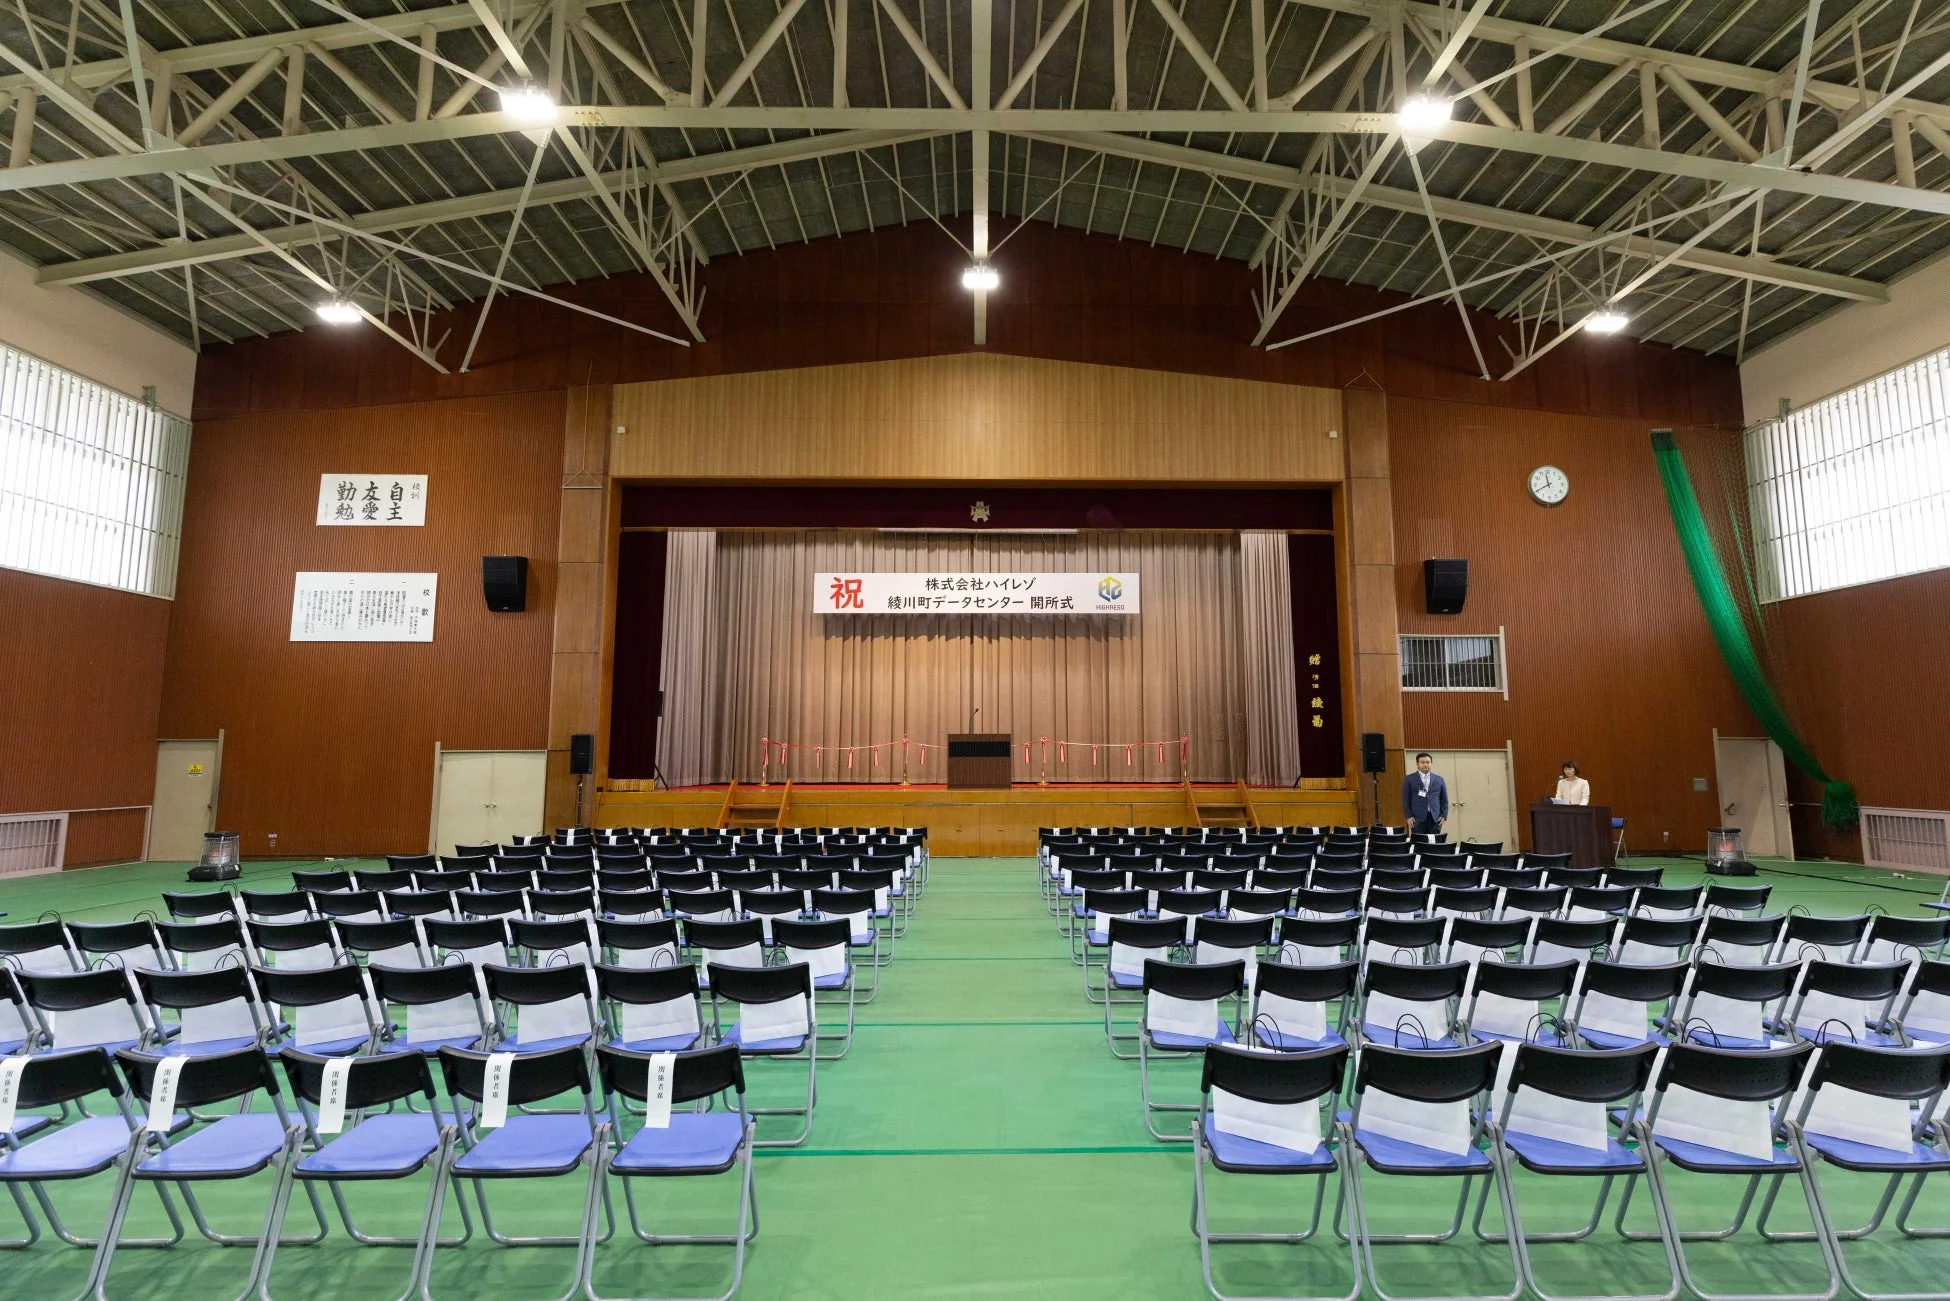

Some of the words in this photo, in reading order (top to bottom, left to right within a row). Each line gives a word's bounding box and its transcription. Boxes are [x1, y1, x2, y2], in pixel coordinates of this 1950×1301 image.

[333, 480, 357, 521] 勤勉
[361, 480, 382, 521] 友愛
[386, 481, 404, 521] 自主
[829, 576, 864, 610] 祝
[925, 577, 1037, 591] 株式会社ハイレゾ
[887, 596, 1024, 610] 綾川町データセンター
[1030, 596, 1074, 610] 開所式
[657, 1065, 666, 1099] 関係者席
